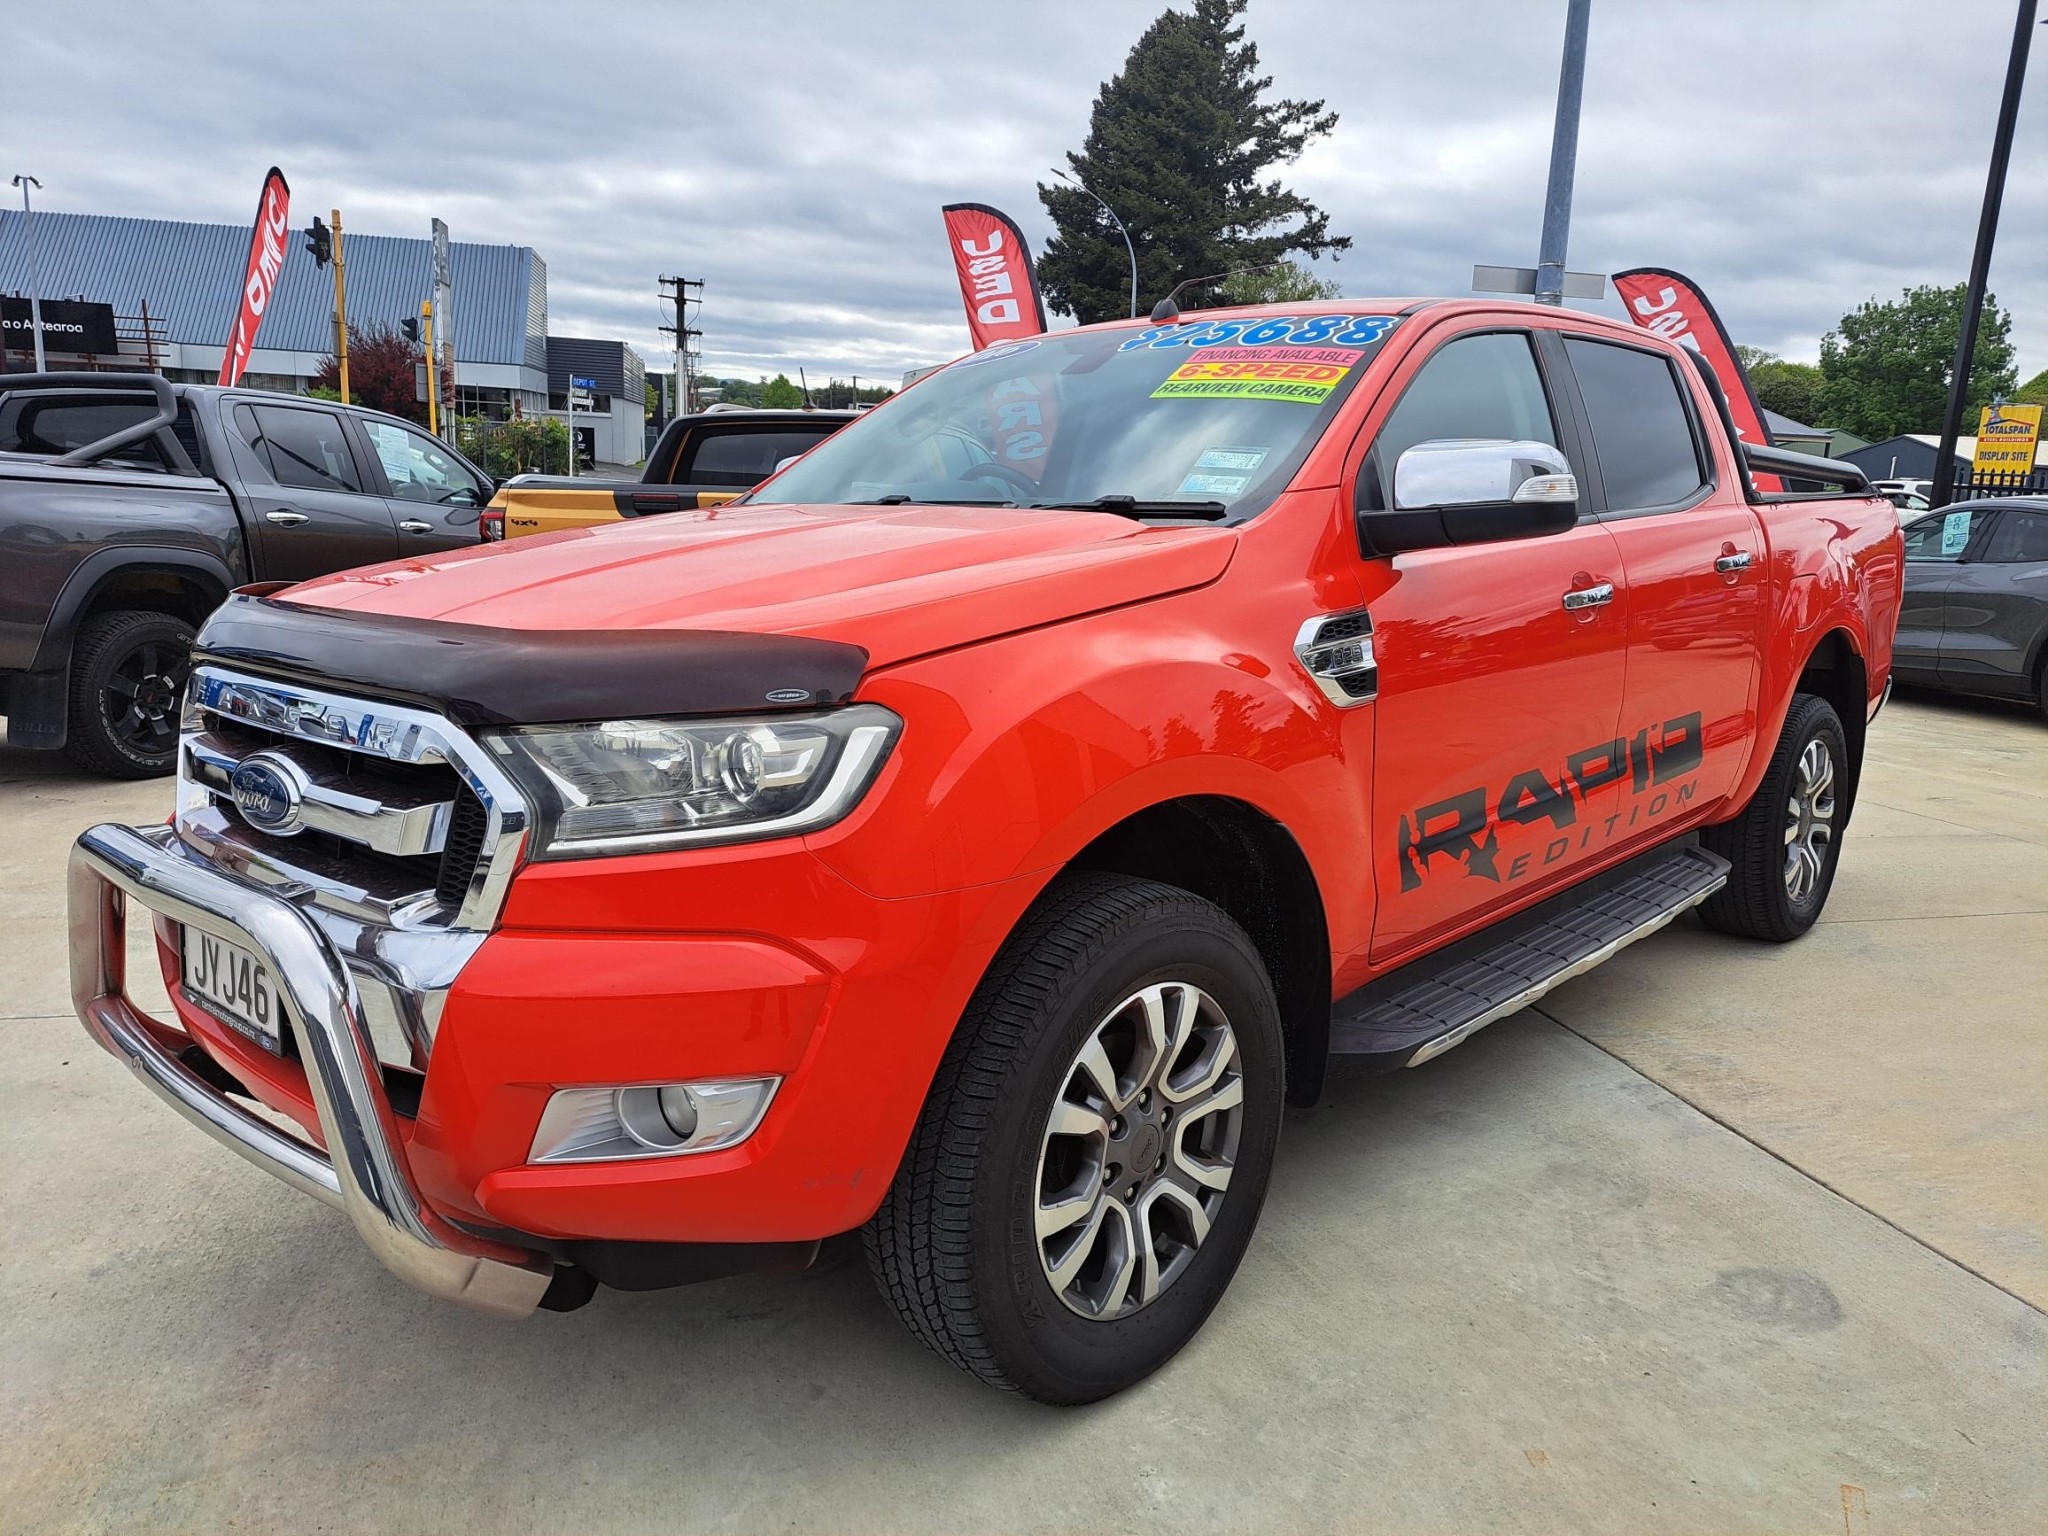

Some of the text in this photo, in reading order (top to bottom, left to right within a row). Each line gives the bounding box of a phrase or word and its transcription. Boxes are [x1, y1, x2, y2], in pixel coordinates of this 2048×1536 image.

[23, 319, 84, 333] Atearoa
[1117, 315, 1399, 352] $25688
[1192, 349, 1357, 363] FINANCING AVAILABLE
[1177, 363, 1341, 381] 6-SPEED
[1159, 382, 1328, 399] REARVIEW CAMERA
[1985, 425, 2031, 435] TOTALSPAN
[1979, 451, 2029, 461] DISPLAY SITE
[236, 770, 276, 813] Ford
[1398, 711, 1703, 894] RAPID
[1508, 779, 1699, 882] EDITION
[195, 932, 269, 1025] JYJ46
